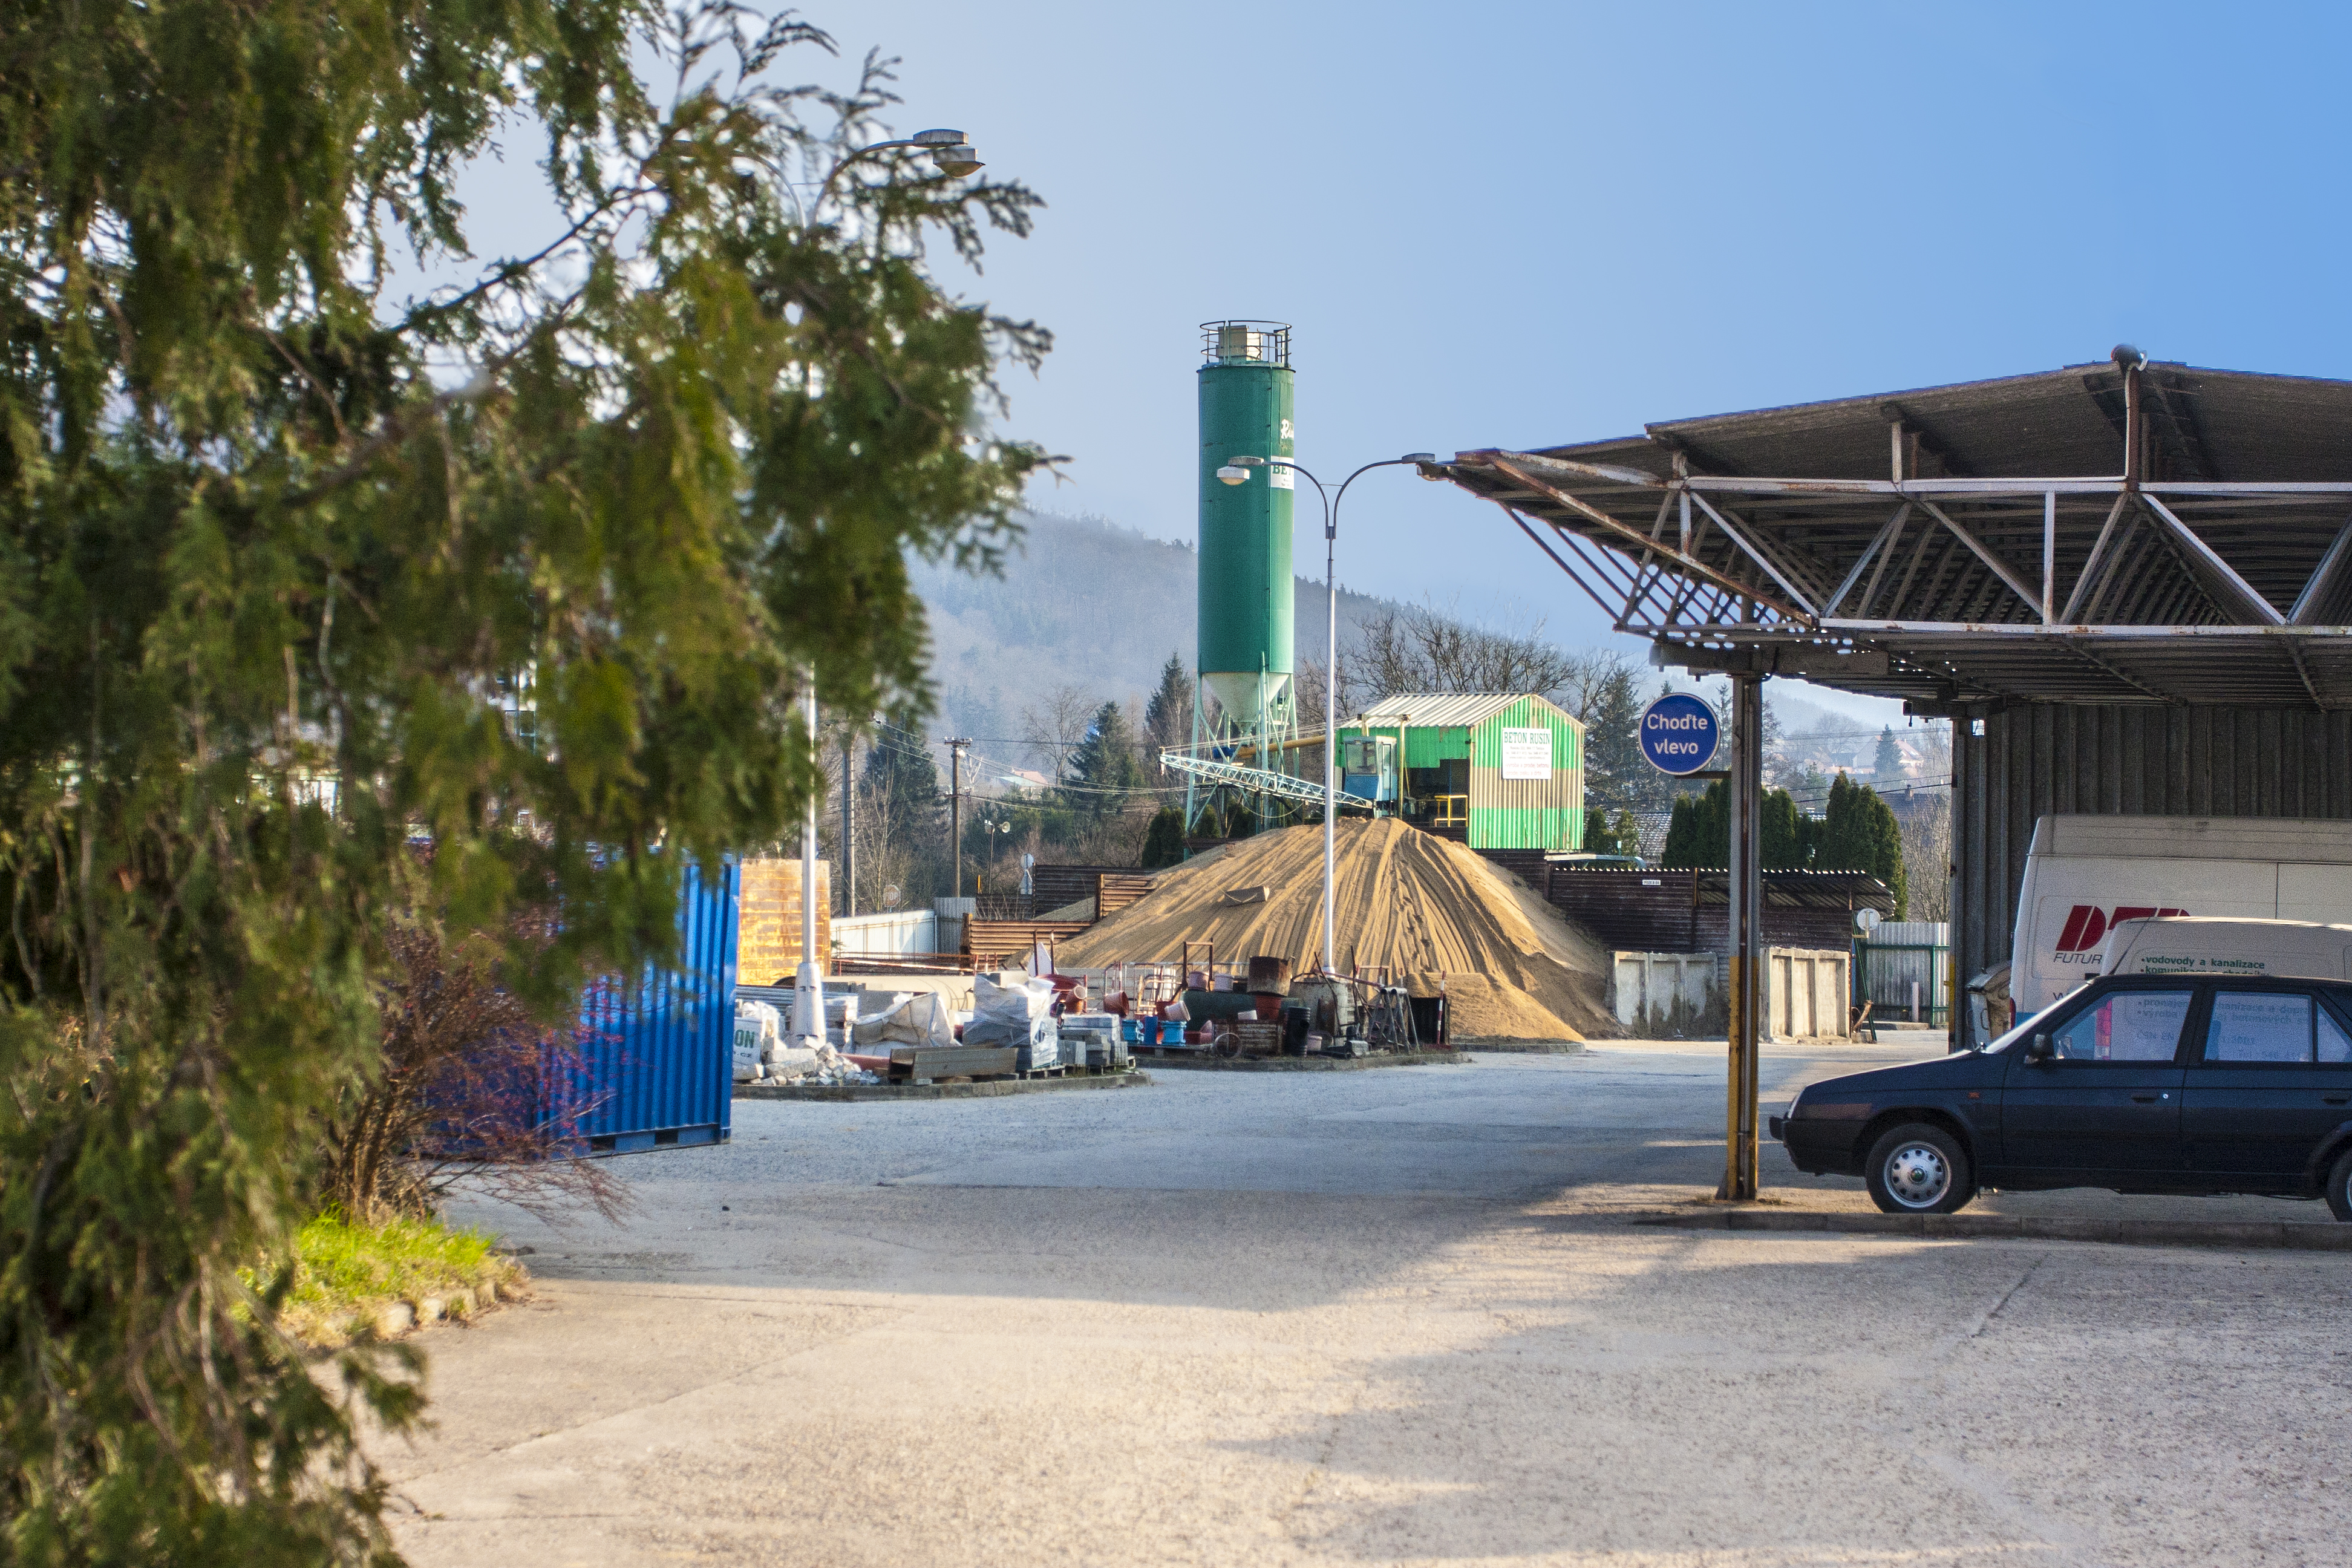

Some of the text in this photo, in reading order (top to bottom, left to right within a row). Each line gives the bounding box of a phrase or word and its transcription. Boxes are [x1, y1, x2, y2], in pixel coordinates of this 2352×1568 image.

[1647, 714, 1708, 730] Choďte
[1504, 731, 1550, 744] BETON RUSÍN
[1654, 738, 1698, 754] vlevo
[2145, 956, 2195, 967] vodovody
[2211, 958, 2265, 969] kanalizace
